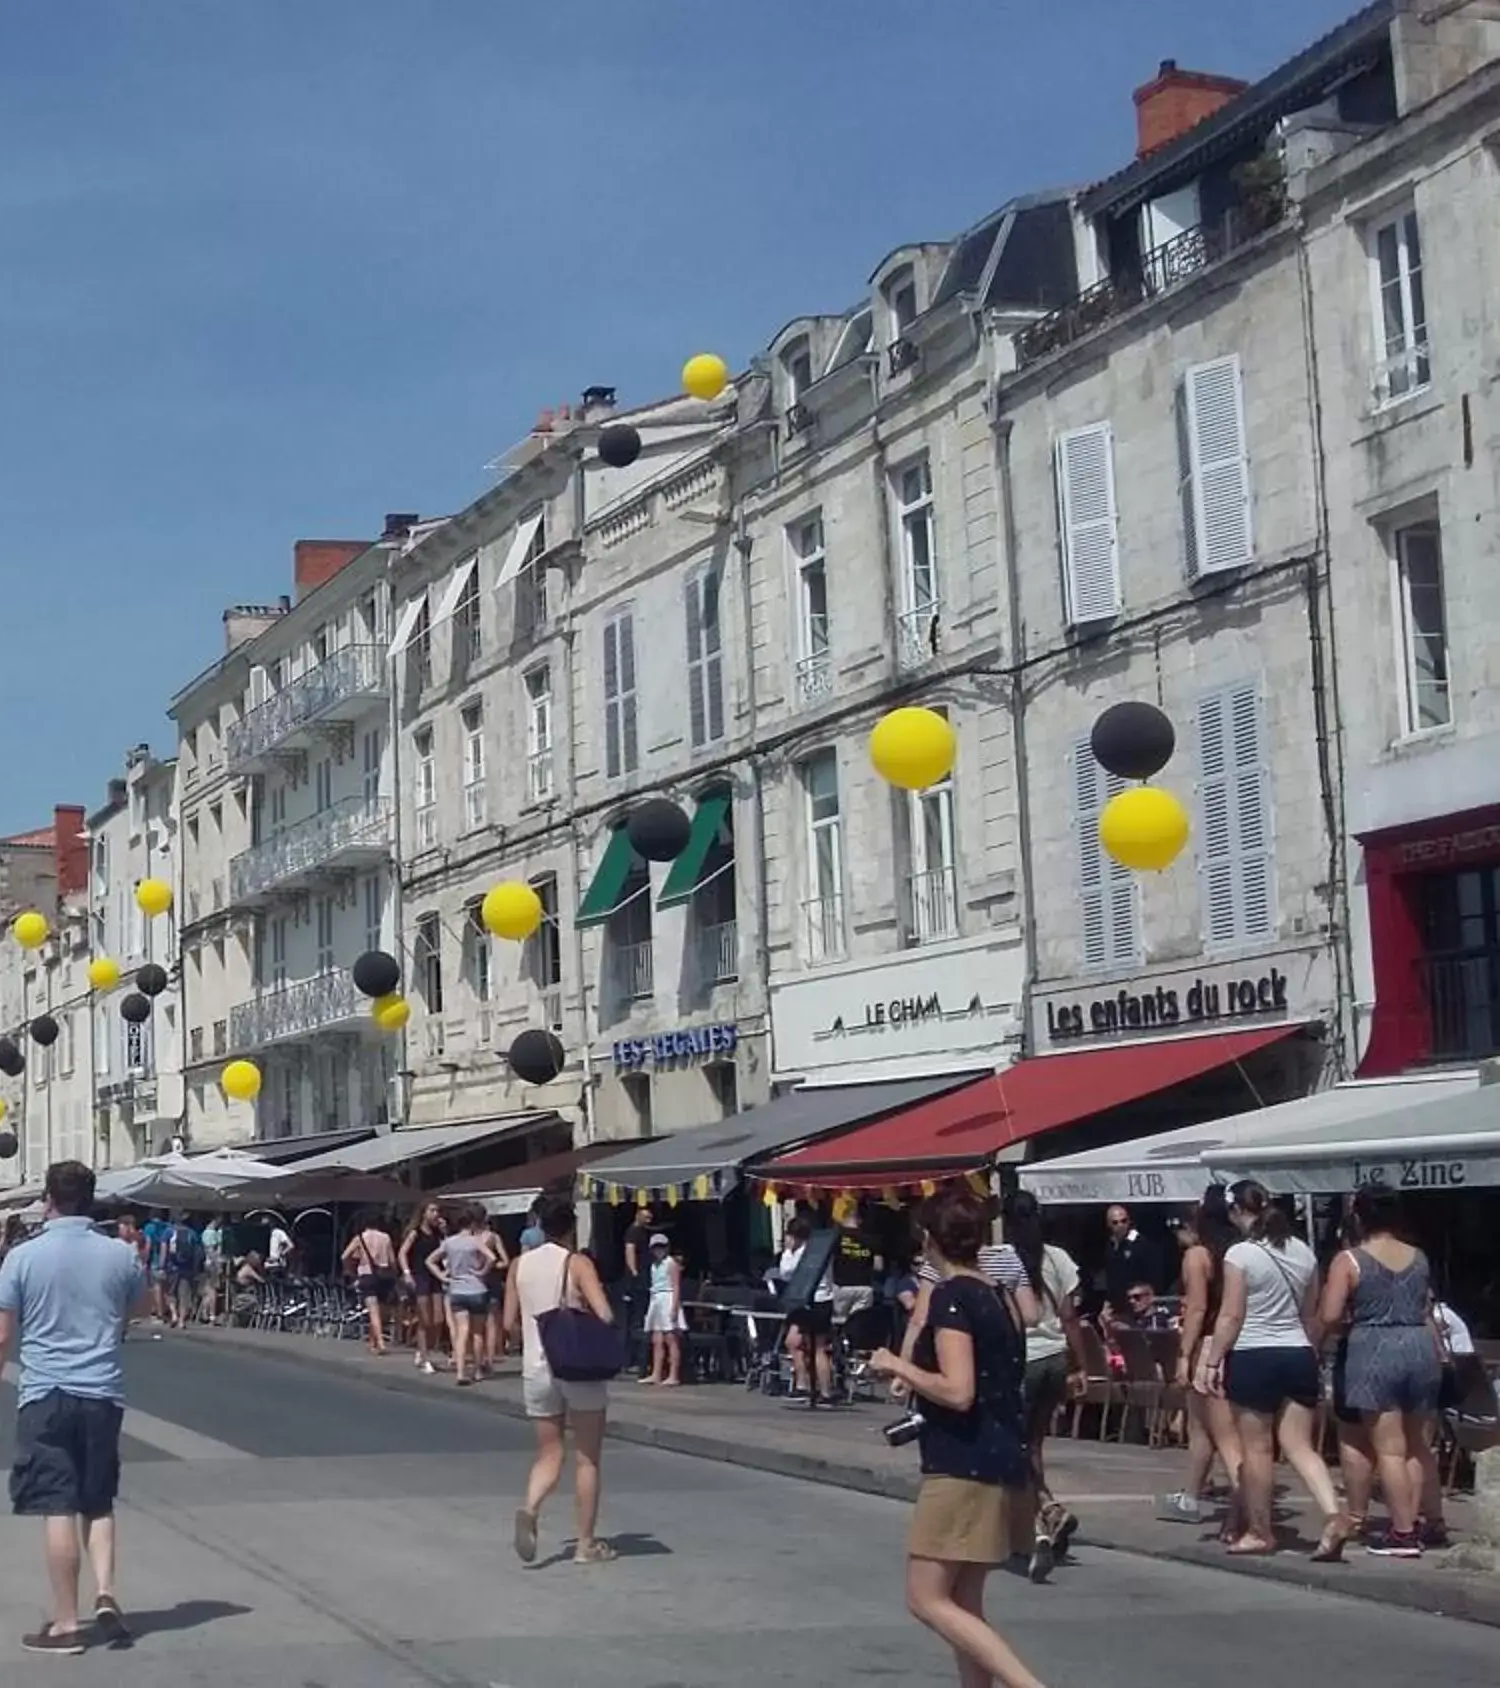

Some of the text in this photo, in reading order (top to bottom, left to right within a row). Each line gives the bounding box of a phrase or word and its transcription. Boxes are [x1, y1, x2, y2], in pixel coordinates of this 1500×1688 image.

[866, 1002, 885, 1025] LE
[1047, 967, 1288, 1037] Les enfants du rock
[1128, 1172, 1166, 1197] PUB
[1353, 1156, 1466, 1188] Le Zinc
